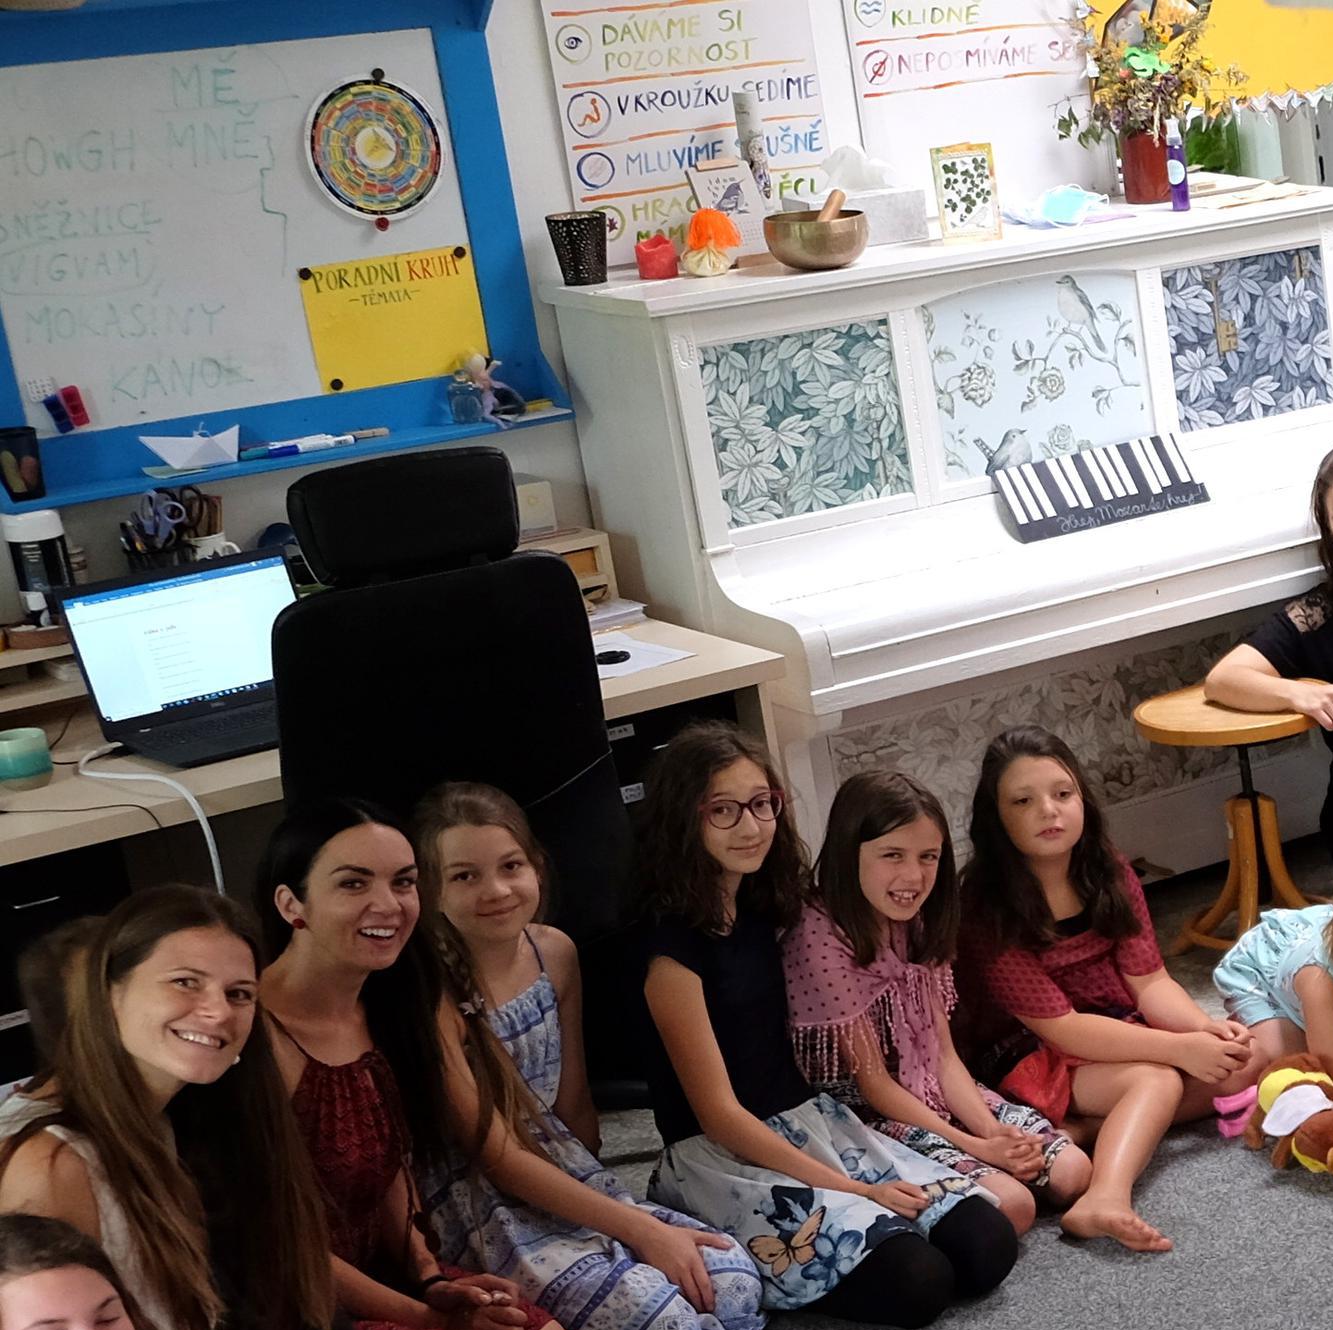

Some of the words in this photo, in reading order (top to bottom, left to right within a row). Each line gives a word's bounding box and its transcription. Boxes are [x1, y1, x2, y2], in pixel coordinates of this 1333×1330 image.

[602, 10, 701, 46] DÁVÁME
[718, 9, 743, 33] SI
[604, 37, 758, 72] POZORNOST
[312, 256, 402, 294] PORADNÍ
[406, 253, 460, 282] KRUH
